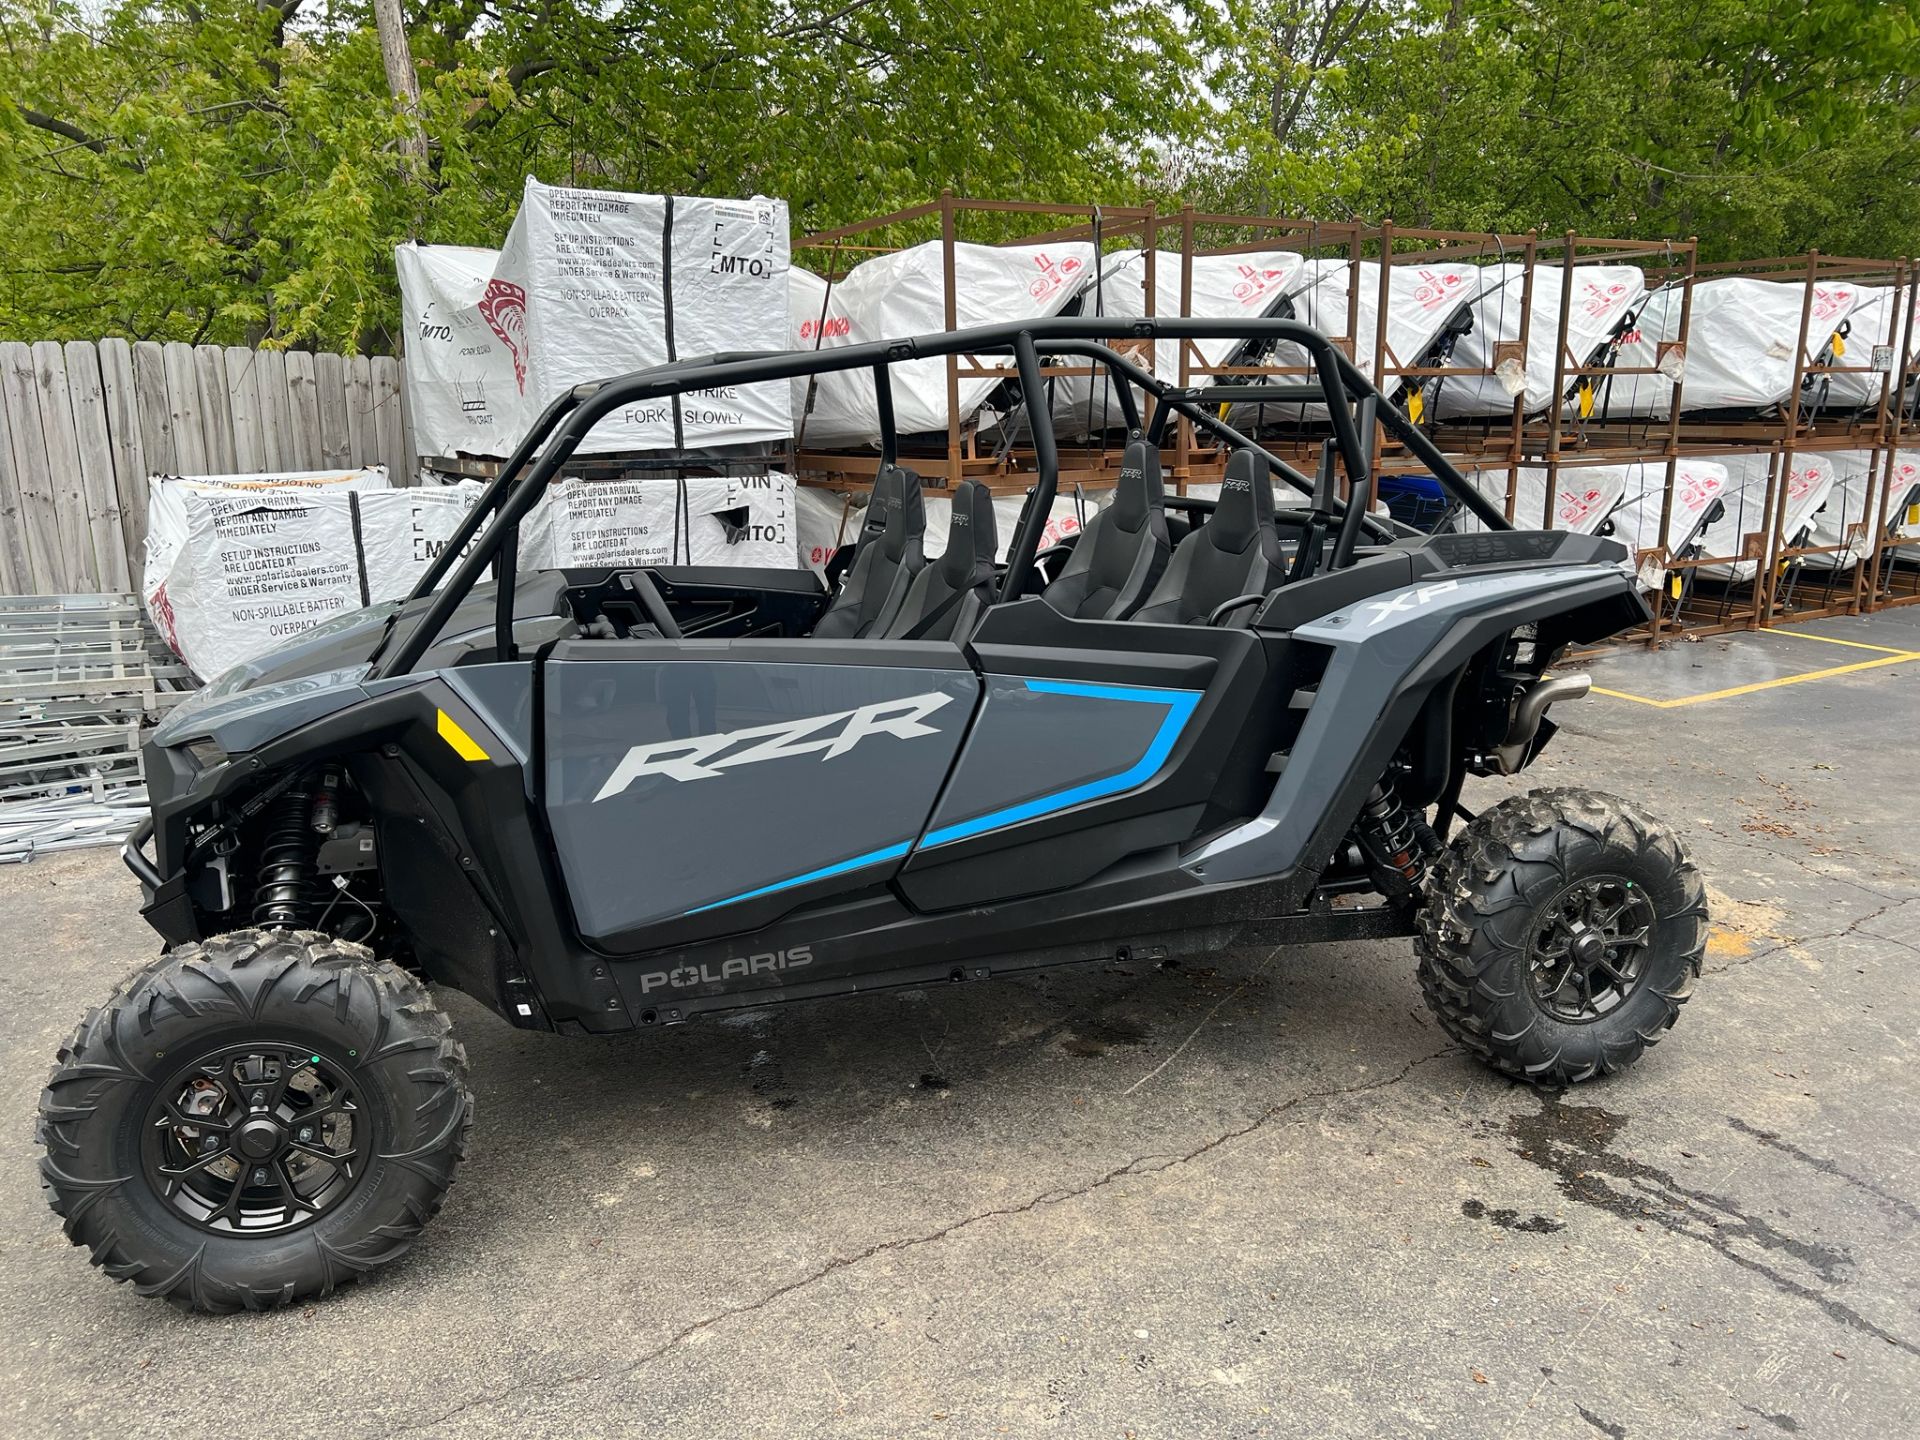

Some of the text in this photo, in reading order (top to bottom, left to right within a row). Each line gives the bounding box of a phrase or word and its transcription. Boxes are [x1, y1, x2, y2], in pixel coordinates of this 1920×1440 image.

[549, 189, 573, 198] OPEN
[572, 191, 592, 200] UPON
[550, 200, 630, 214] REPORT ANY DAMAGE
[550, 211, 601, 223] IMMEDIATELY
[568, 234, 580, 244] UP
[580, 236, 635, 247] INSTRUCTIONS
[556, 244, 572, 254] ARE
[606, 247, 614, 256] AT
[559, 266, 656, 280] UNDER Service & Warranty
[720, 255, 763, 276] MTO
[561, 289, 650, 302] NON-SPILLABLE BATTERY
[590, 306, 630, 318] OVERPACK
[422, 324, 450, 340] MTO
[625, 408, 743, 424] FORK SLOWLY
[739, 476, 771, 489] VIN
[1223, 478, 1250, 492] RZR
[568, 486, 641, 500] OPEN UPON ARRIVAL
[211, 504, 236, 516] OPEN
[236, 499, 260, 510] UPON
[262, 496, 302, 506] ARRIVAL
[568, 496, 643, 510] REPORT ANY DAMAGE
[214, 507, 308, 528] REPORT ANY DAMAGE
[569, 508, 618, 520] IMMEDIATELY
[216, 523, 277, 539] IMMEDIATELY
[572, 526, 648, 541] SET UP INSTRUCTIONS
[741, 525, 777, 542] TO
[221, 542, 321, 562] SET UP INSTRUCTIONS
[426, 540, 472, 558] MO
[572, 538, 628, 552] ARE LOCATED AT
[574, 546, 668, 562] www.polarisdealers.com
[599, 558, 626, 568] Service
[628, 558, 634, 566] &
[634, 556, 669, 566] Warranty
[224, 556, 296, 574] ARE LOCATED AT
[226, 562, 348, 585] www.polarisdealers.com
[228, 574, 352, 597] UNDER Service & Warranty
[232, 596, 346, 623] NON-SPILLABLE BATTERY
[1367, 580, 1459, 628] XP
[270, 619, 318, 637] OVERPACK
[592, 691, 955, 804] RZR
[640, 946, 814, 994] POLARIS
